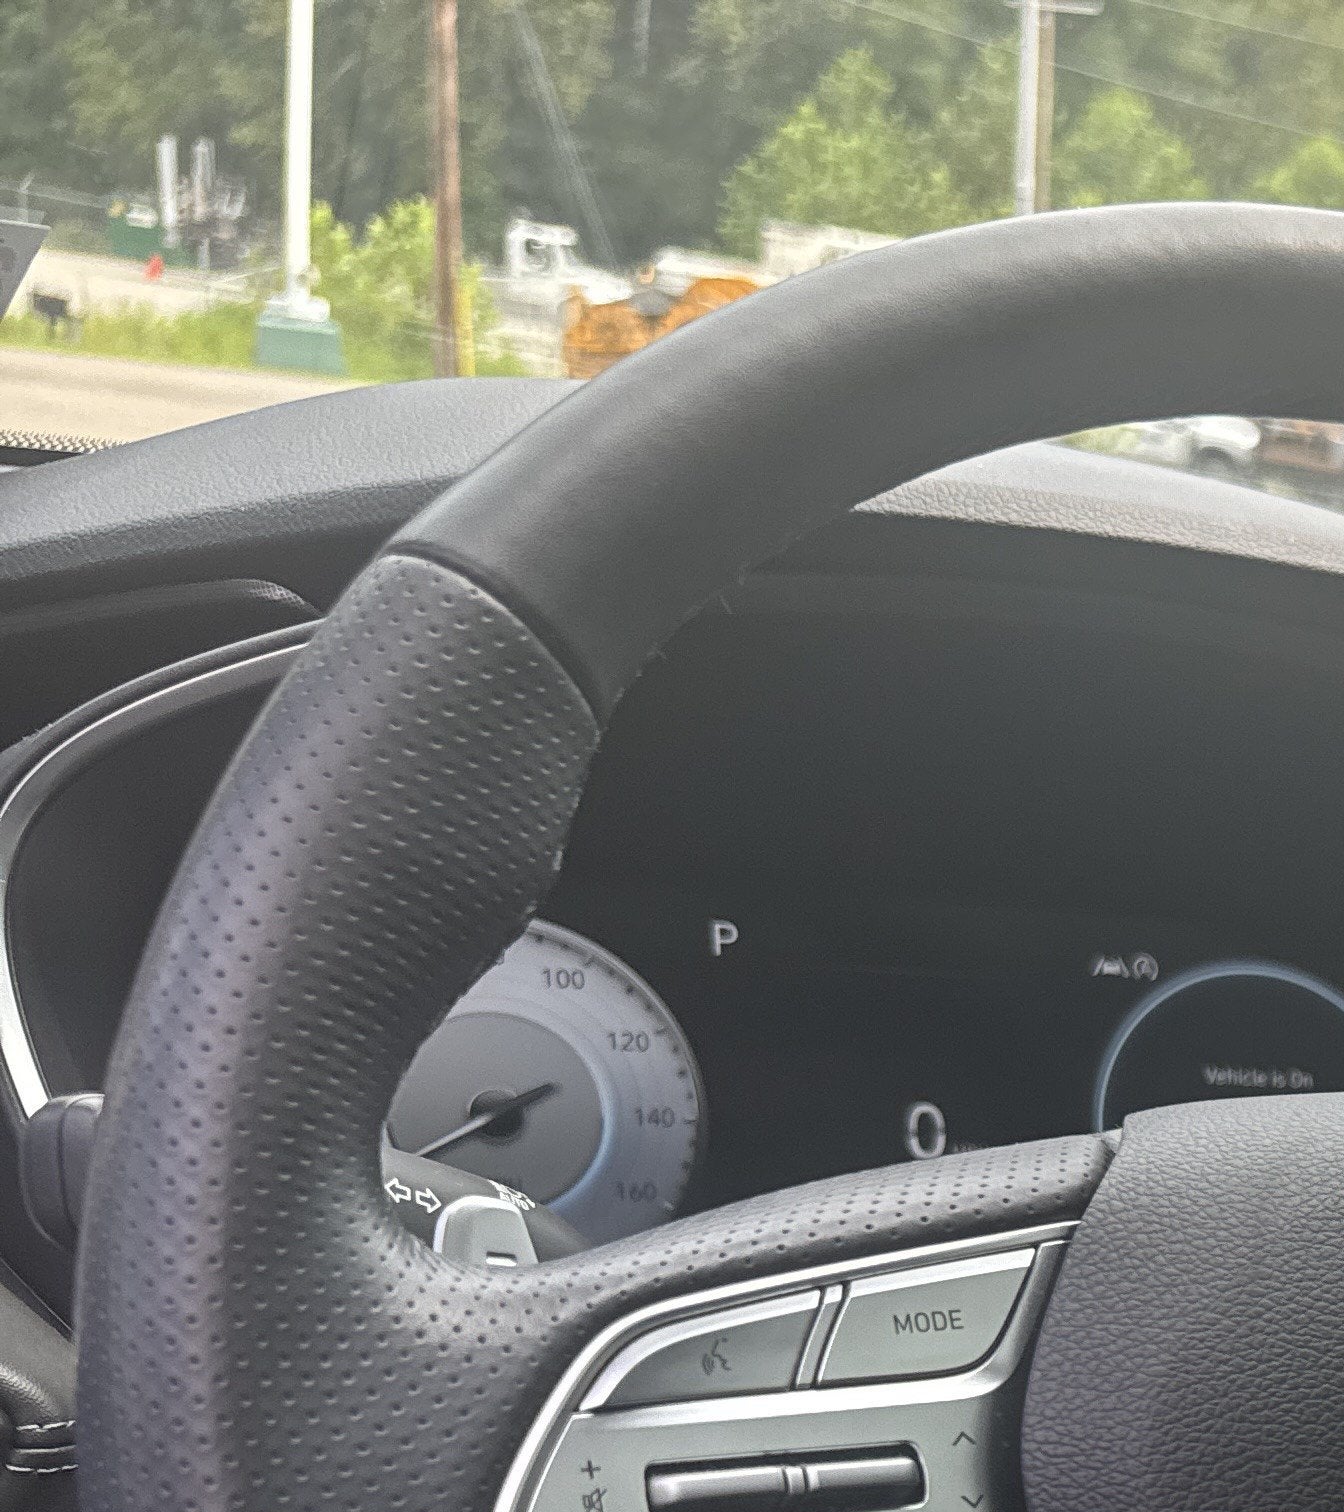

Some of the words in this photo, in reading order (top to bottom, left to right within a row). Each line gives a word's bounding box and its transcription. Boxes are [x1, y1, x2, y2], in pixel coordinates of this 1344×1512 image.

[710, 919, 740, 957] P
[541, 967, 586, 990] 100
[607, 1031, 651, 1053] 120
[1203, 1064, 1267, 1087] Vehicle
[1271, 1068, 1287, 1088] is
[1289, 1067, 1314, 1089] On
[635, 1107, 675, 1128] 140
[908, 1101, 947, 1159] 0
[616, 1181, 658, 1201] 160
[892, 1309, 965, 1335] MODE
